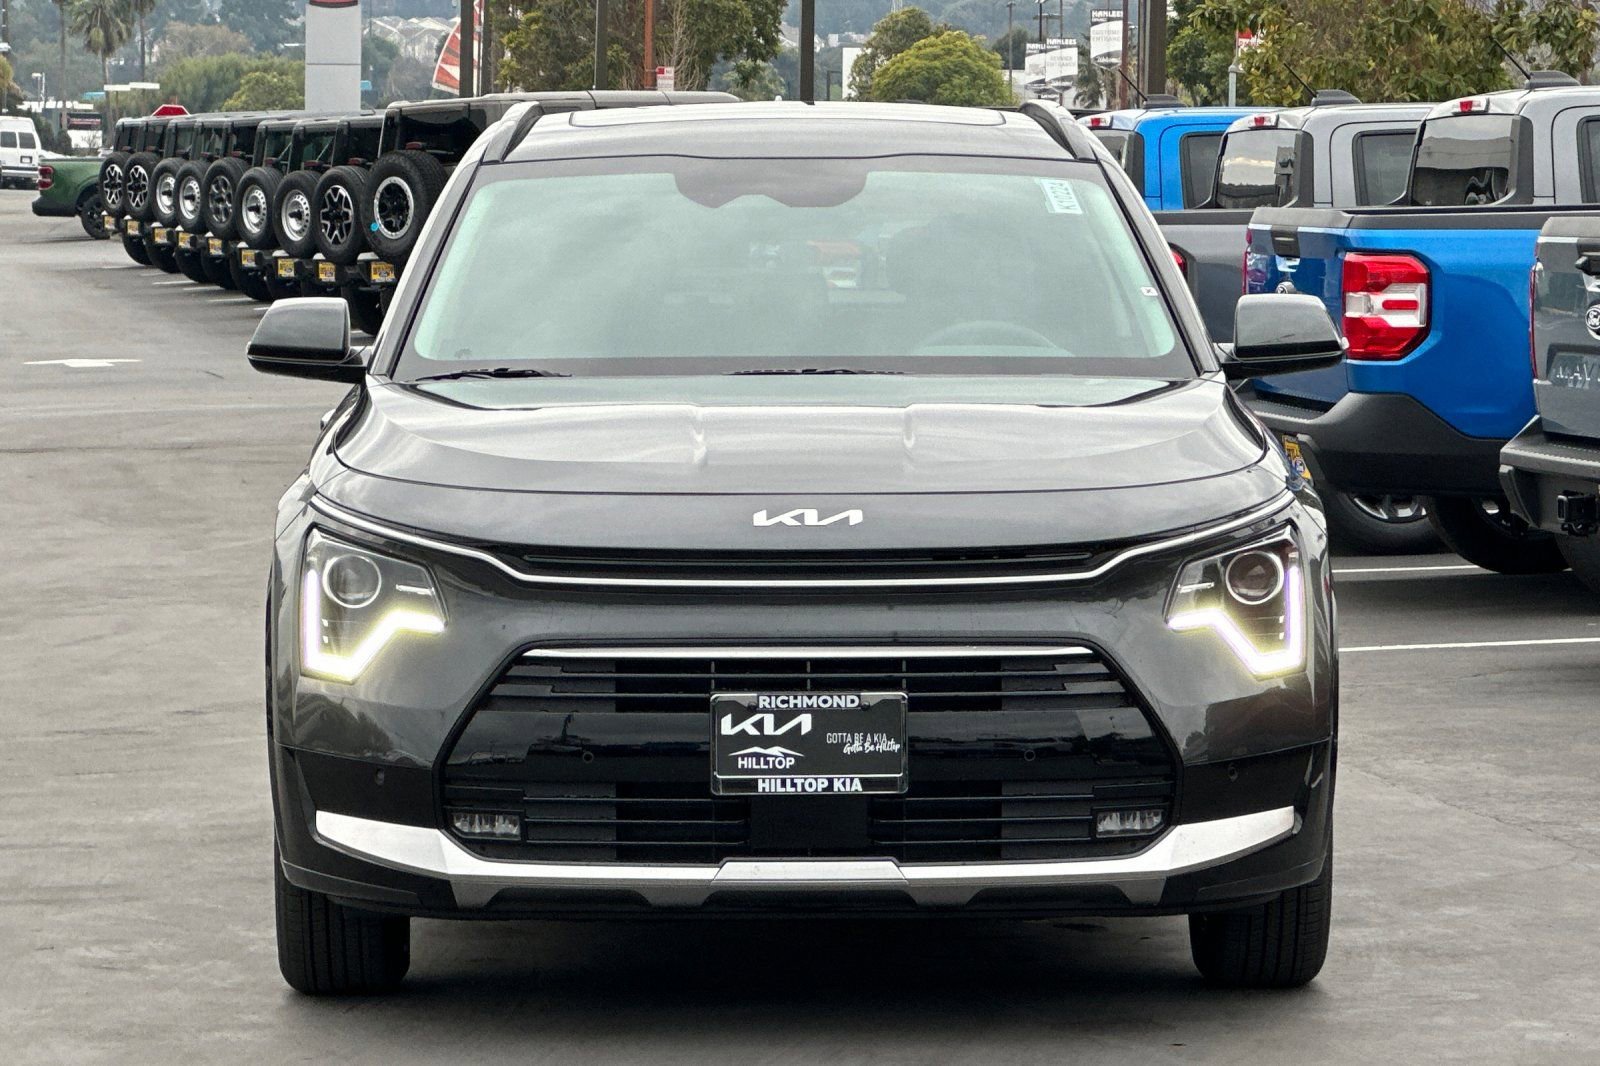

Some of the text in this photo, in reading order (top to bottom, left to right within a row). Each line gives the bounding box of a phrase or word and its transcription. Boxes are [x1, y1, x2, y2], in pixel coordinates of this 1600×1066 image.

[753, 509, 863, 526] KIA
[758, 695, 860, 709] RICHMOND
[720, 713, 812, 736] KIA
[826, 732, 852, 744] GOTTA
[854, 732, 864, 745] BE
[874, 732, 887, 744] KIA
[864, 741, 876, 754] Be
[738, 756, 795, 769] HILLTOP
[757, 778, 863, 793] HILLTOP KIA
